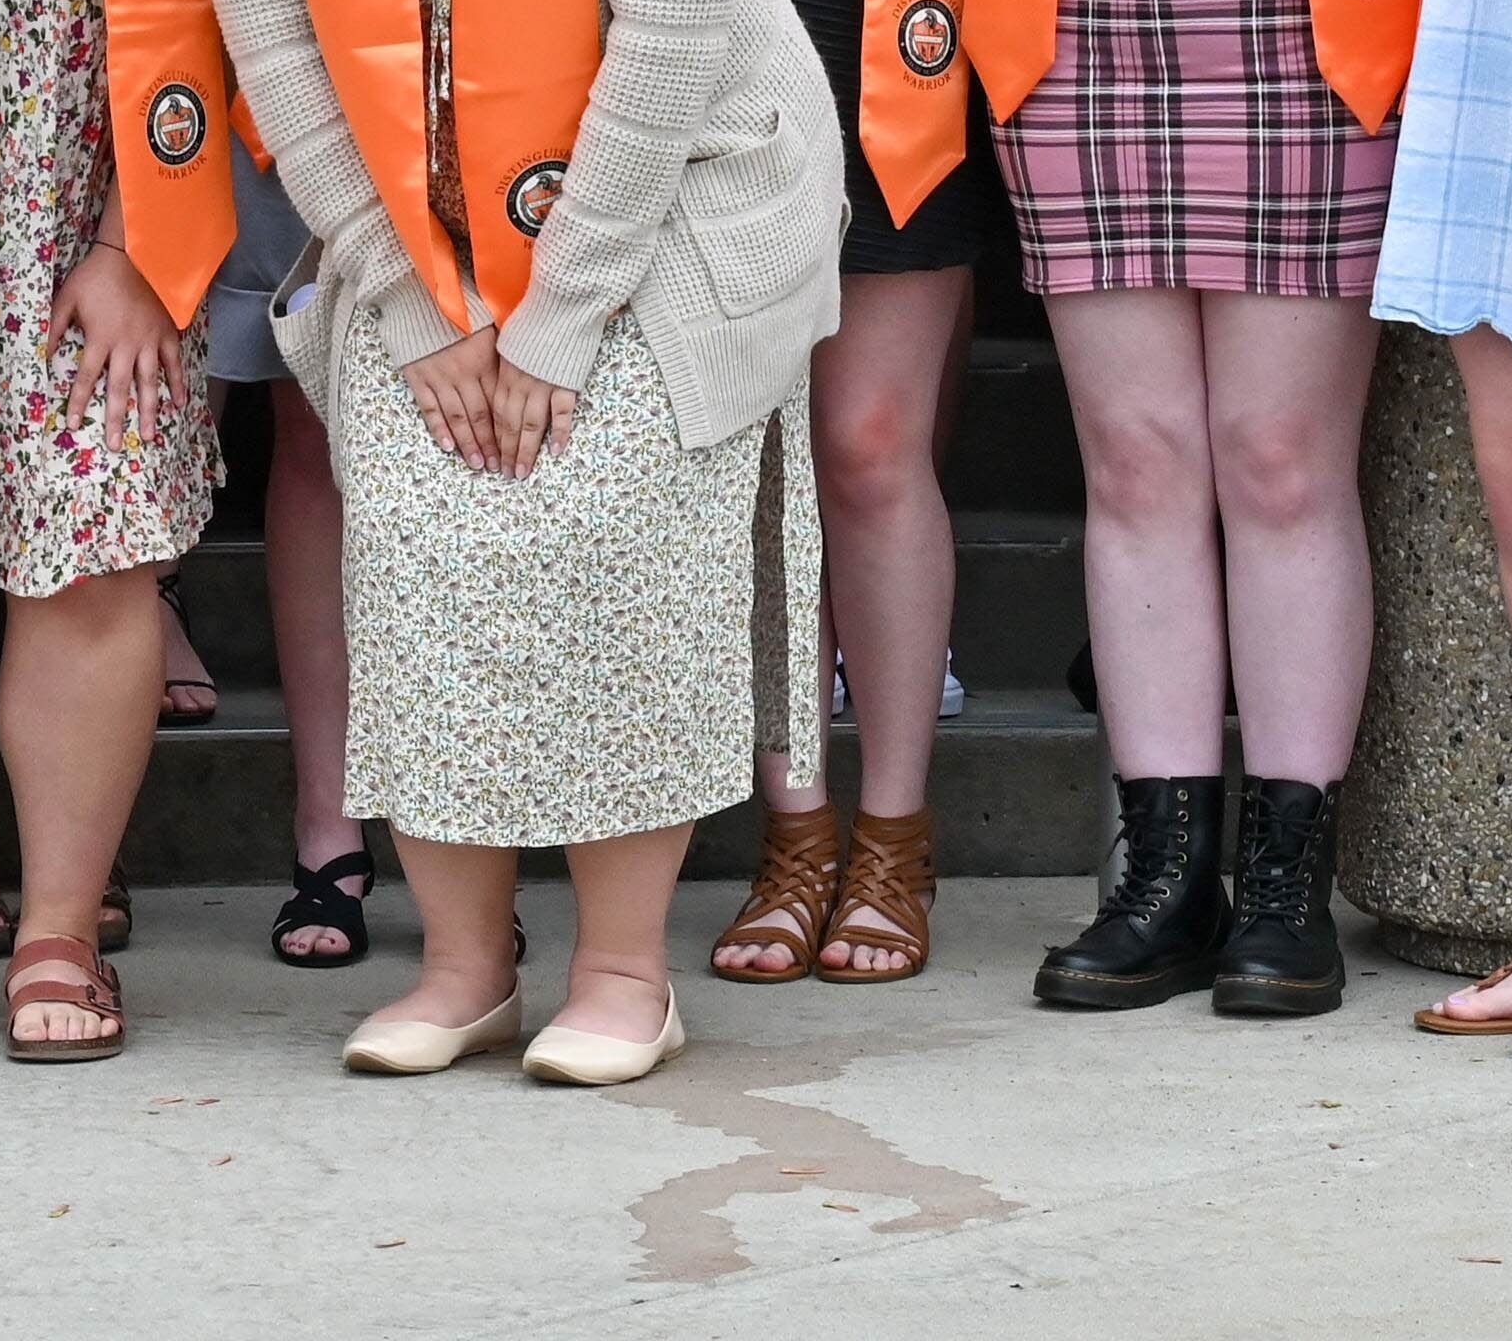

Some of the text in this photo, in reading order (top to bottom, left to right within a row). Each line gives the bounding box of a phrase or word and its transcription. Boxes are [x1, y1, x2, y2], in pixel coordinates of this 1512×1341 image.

[138, 69, 210, 117] DISTINGUISHED
[903, 71, 952, 91] WARRIOR
[157, 154, 207, 180] WARRIOR
